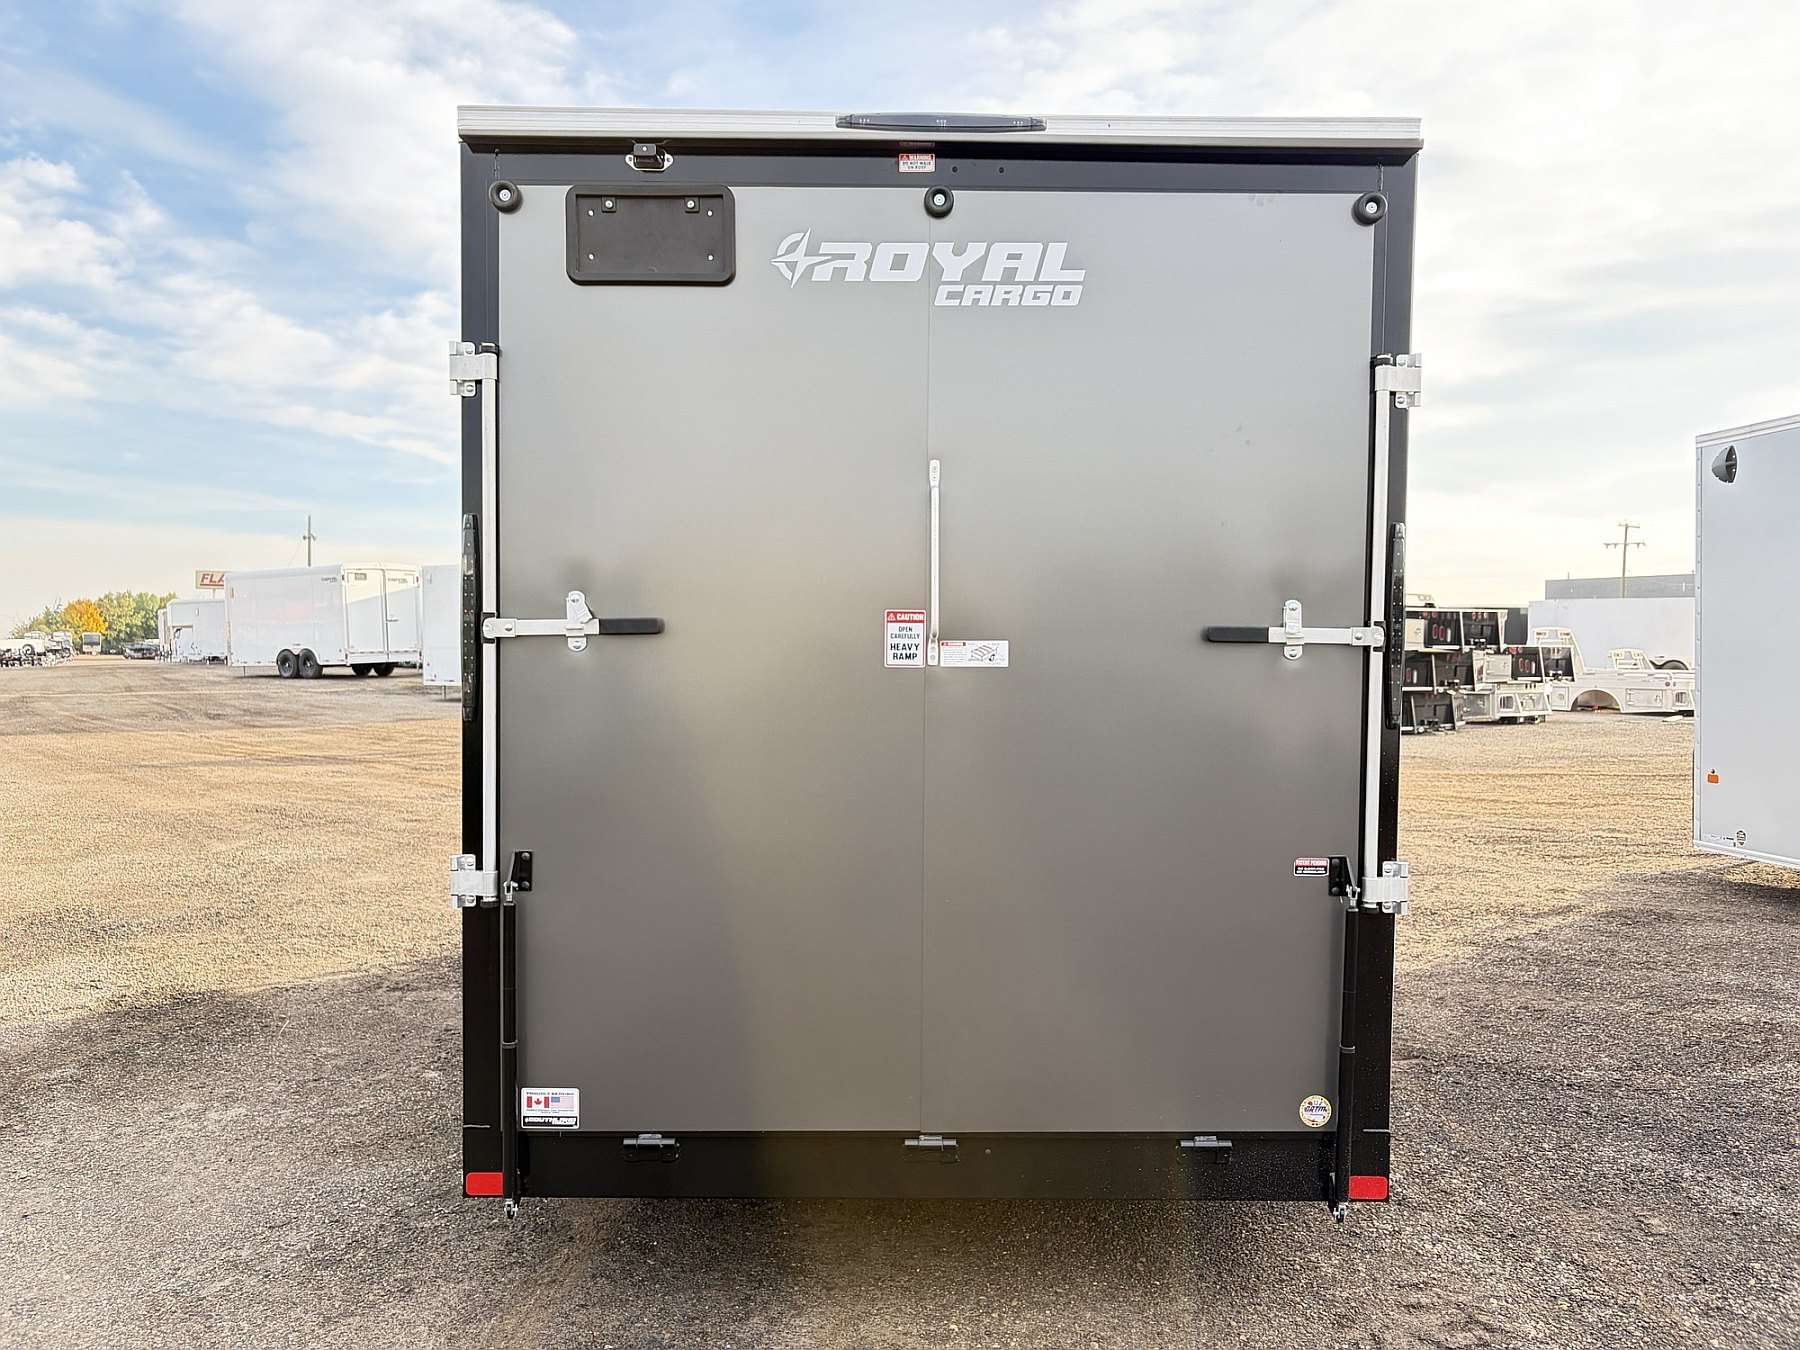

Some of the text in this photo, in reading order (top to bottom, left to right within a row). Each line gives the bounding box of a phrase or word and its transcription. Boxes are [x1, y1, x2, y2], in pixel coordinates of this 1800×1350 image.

[811, 242, 1087, 282] ROYAL
[934, 284, 1084, 306] CARGO
[896, 613, 924, 621] CAUTION
[890, 643, 920, 651] HEAVY
[892, 652, 918, 661] RAMP
